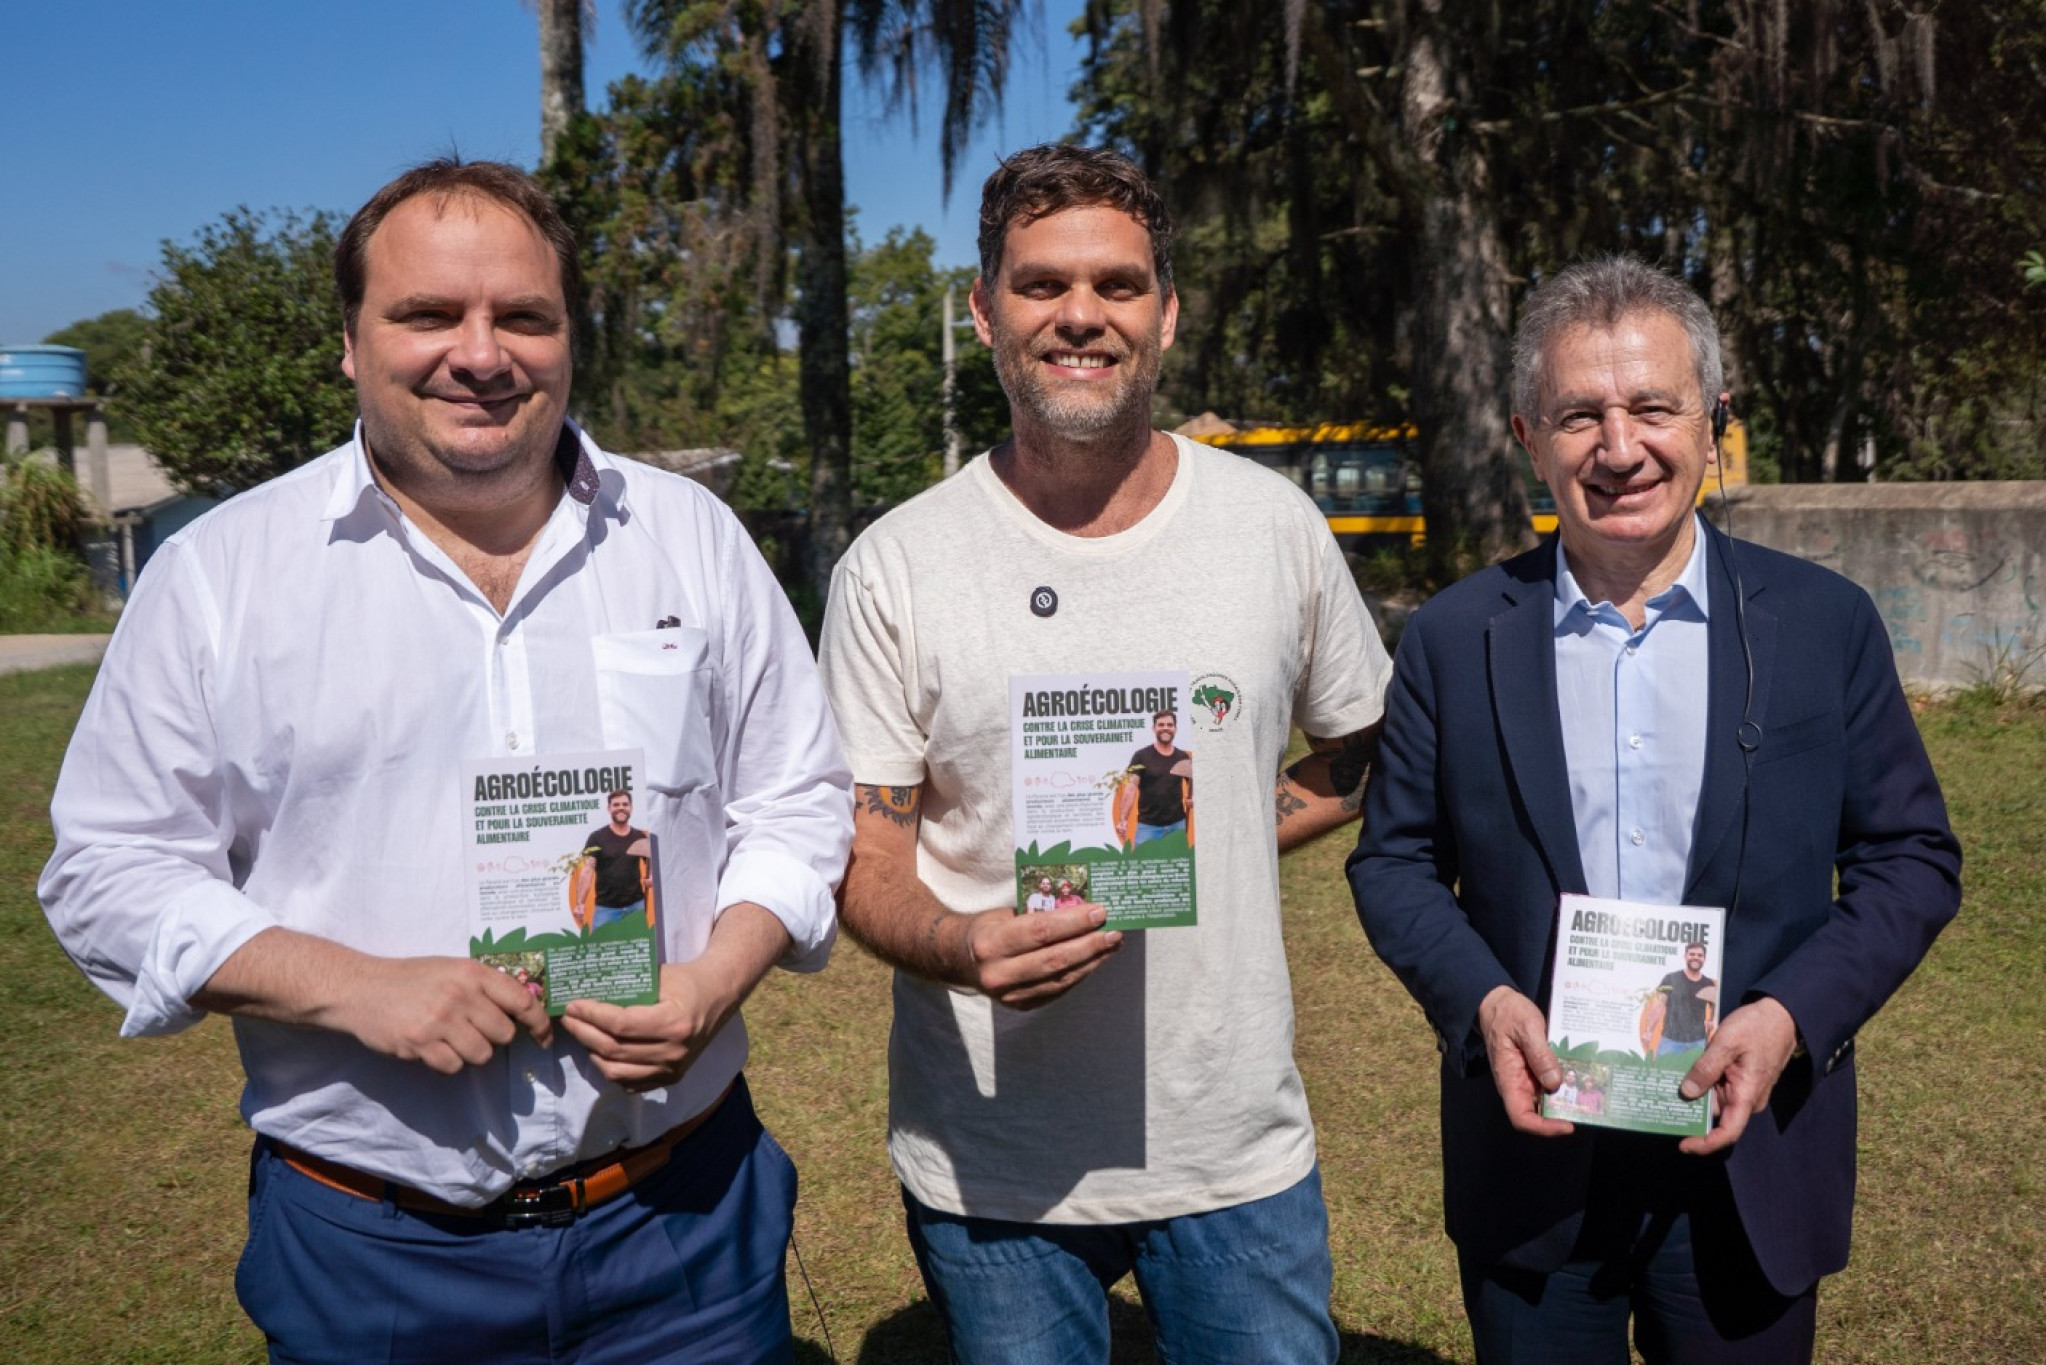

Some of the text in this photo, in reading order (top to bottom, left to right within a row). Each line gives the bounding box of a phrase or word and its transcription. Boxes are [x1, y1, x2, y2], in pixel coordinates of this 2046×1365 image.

[1023, 683, 1178, 717] AGROÉCOLOGIE
[1023, 718, 1145, 732] CONTRE LA CRISE CLIMATIQUE
[1023, 735, 1033, 746] ET
[1036, 734, 1058, 746] POUR
[1060, 734, 1071, 745] LA
[1024, 747, 1077, 759] ALIMENTAIRE
[475, 765, 633, 801] AGROÉCOLOGIE
[475, 799, 599, 817] CONTRE LA CRISE CLIMATIQUE
[475, 819, 484, 831] ET
[487, 818, 510, 830] POUR
[513, 817, 523, 828] LA
[476, 830, 530, 844] ALIMENTAIRE
